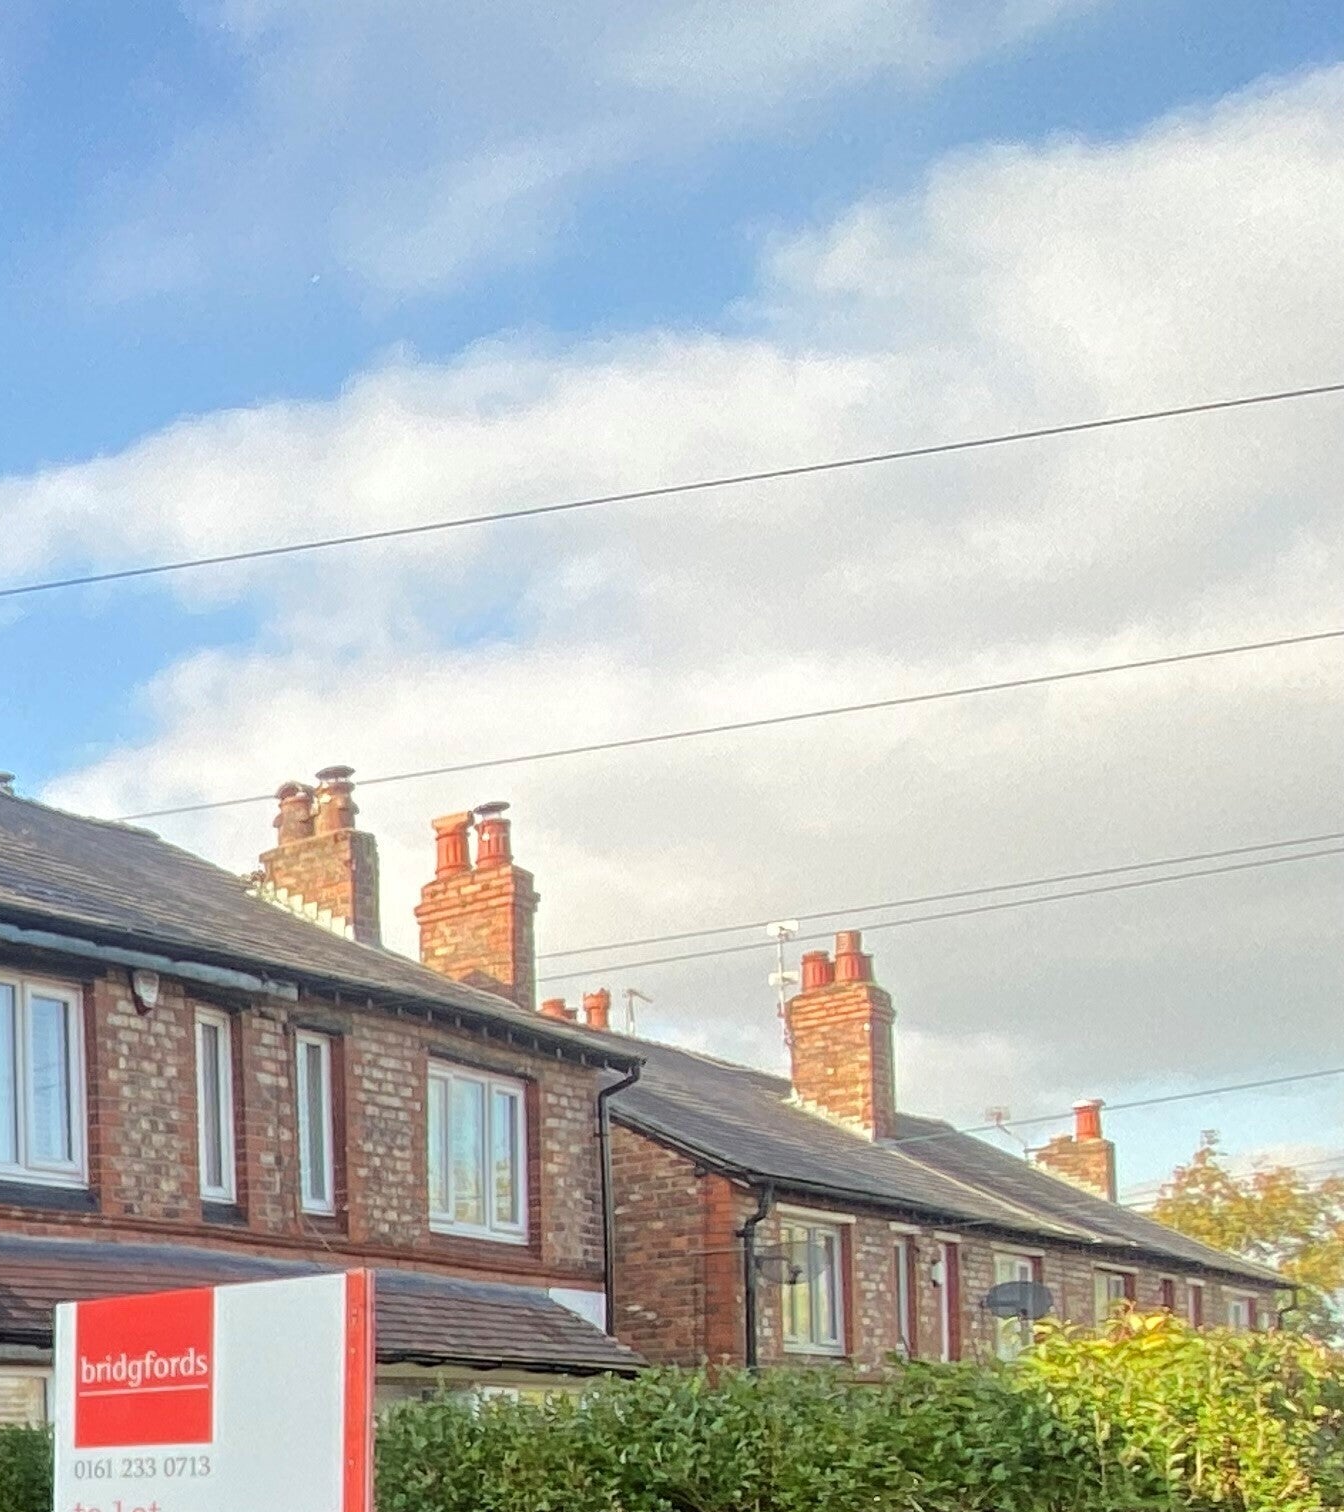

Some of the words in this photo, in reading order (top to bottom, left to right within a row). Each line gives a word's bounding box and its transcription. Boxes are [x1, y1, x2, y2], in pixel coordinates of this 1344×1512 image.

[81, 1347, 208, 1388] bridgfords
[74, 1459, 113, 1479] 0161
[121, 1457, 157, 1478] 233
[163, 1455, 211, 1477] 0713
